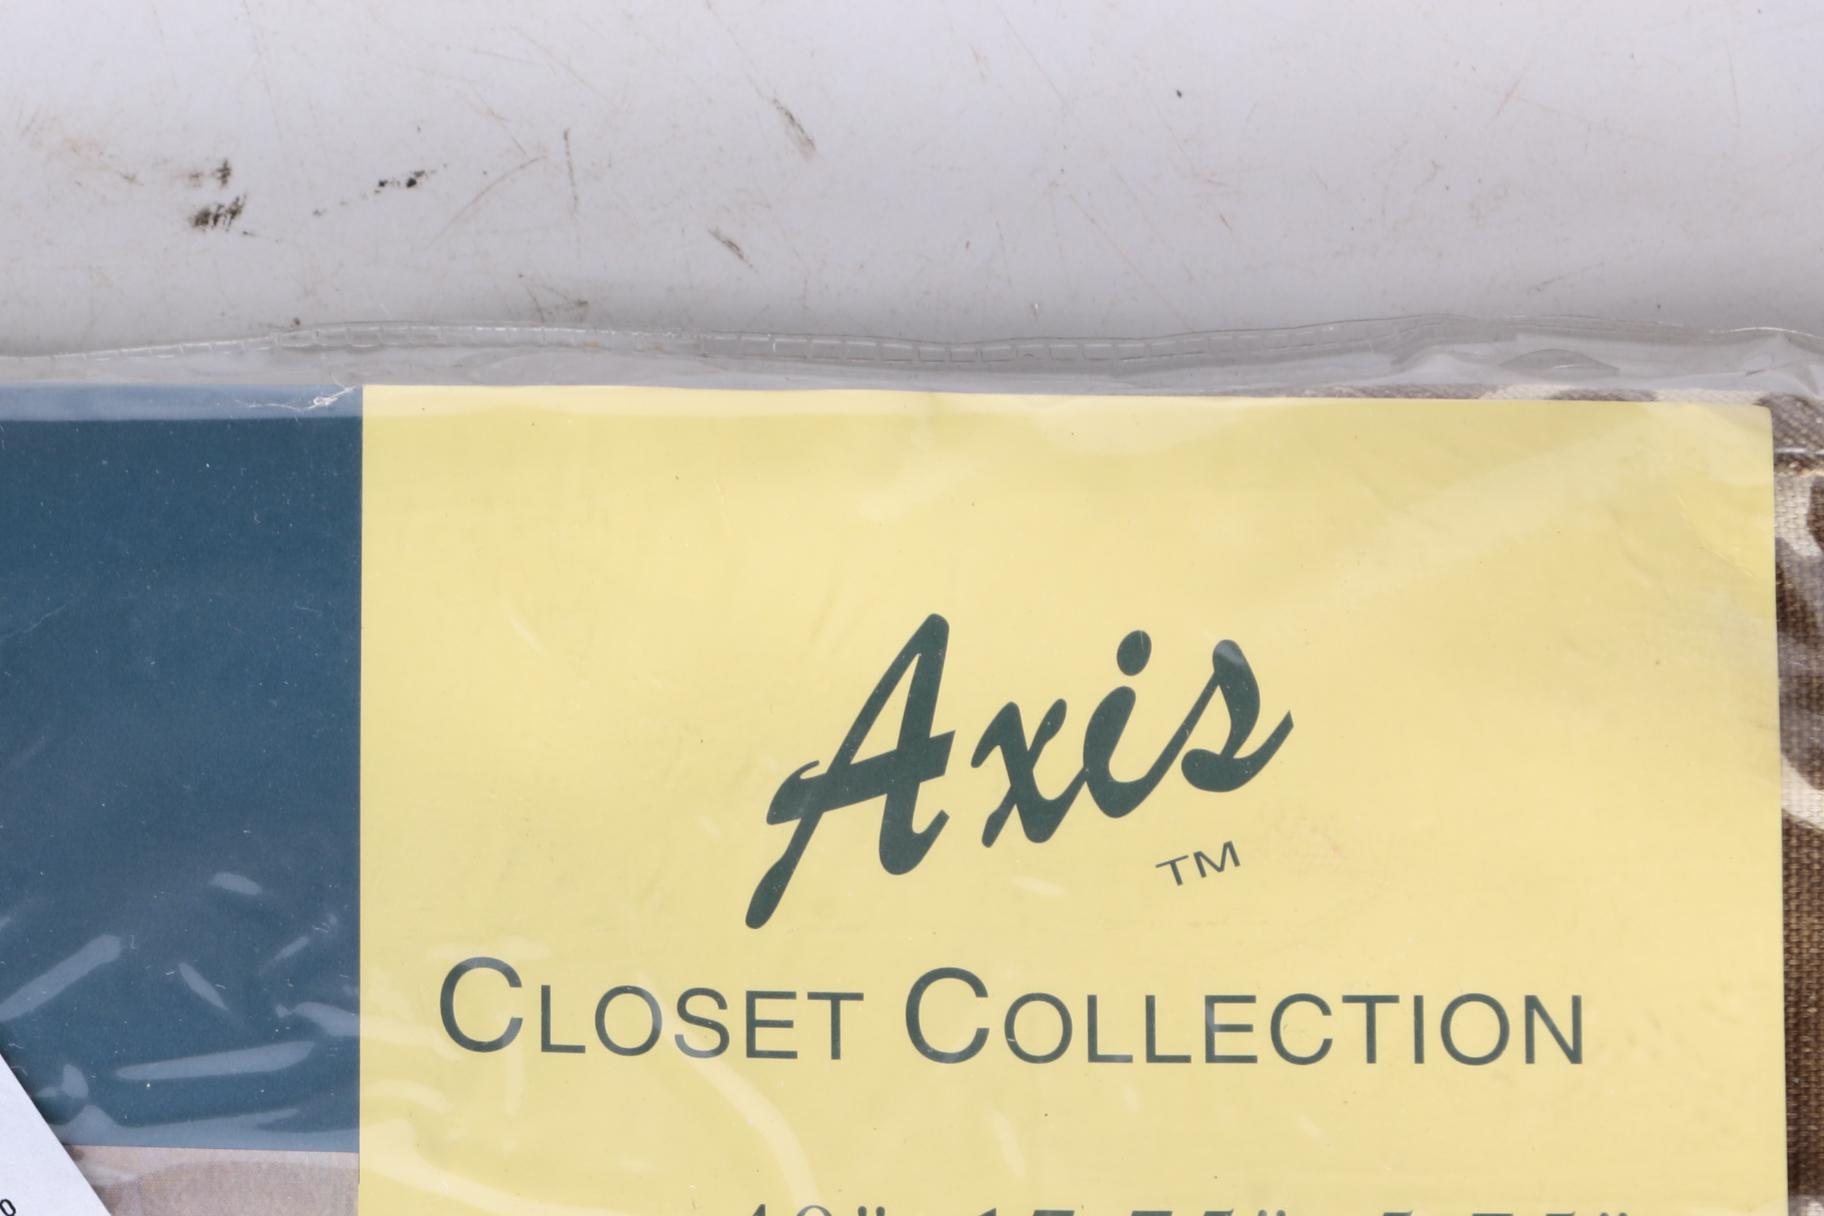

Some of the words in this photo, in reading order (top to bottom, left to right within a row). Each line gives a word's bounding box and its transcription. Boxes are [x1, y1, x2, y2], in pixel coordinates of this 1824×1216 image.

[744, 612, 1294, 930] Axis
[1156, 839, 1243, 887] TM
[438, 956, 865, 1059] CLOSET
[903, 966, 1586, 1066] COLLECTION
